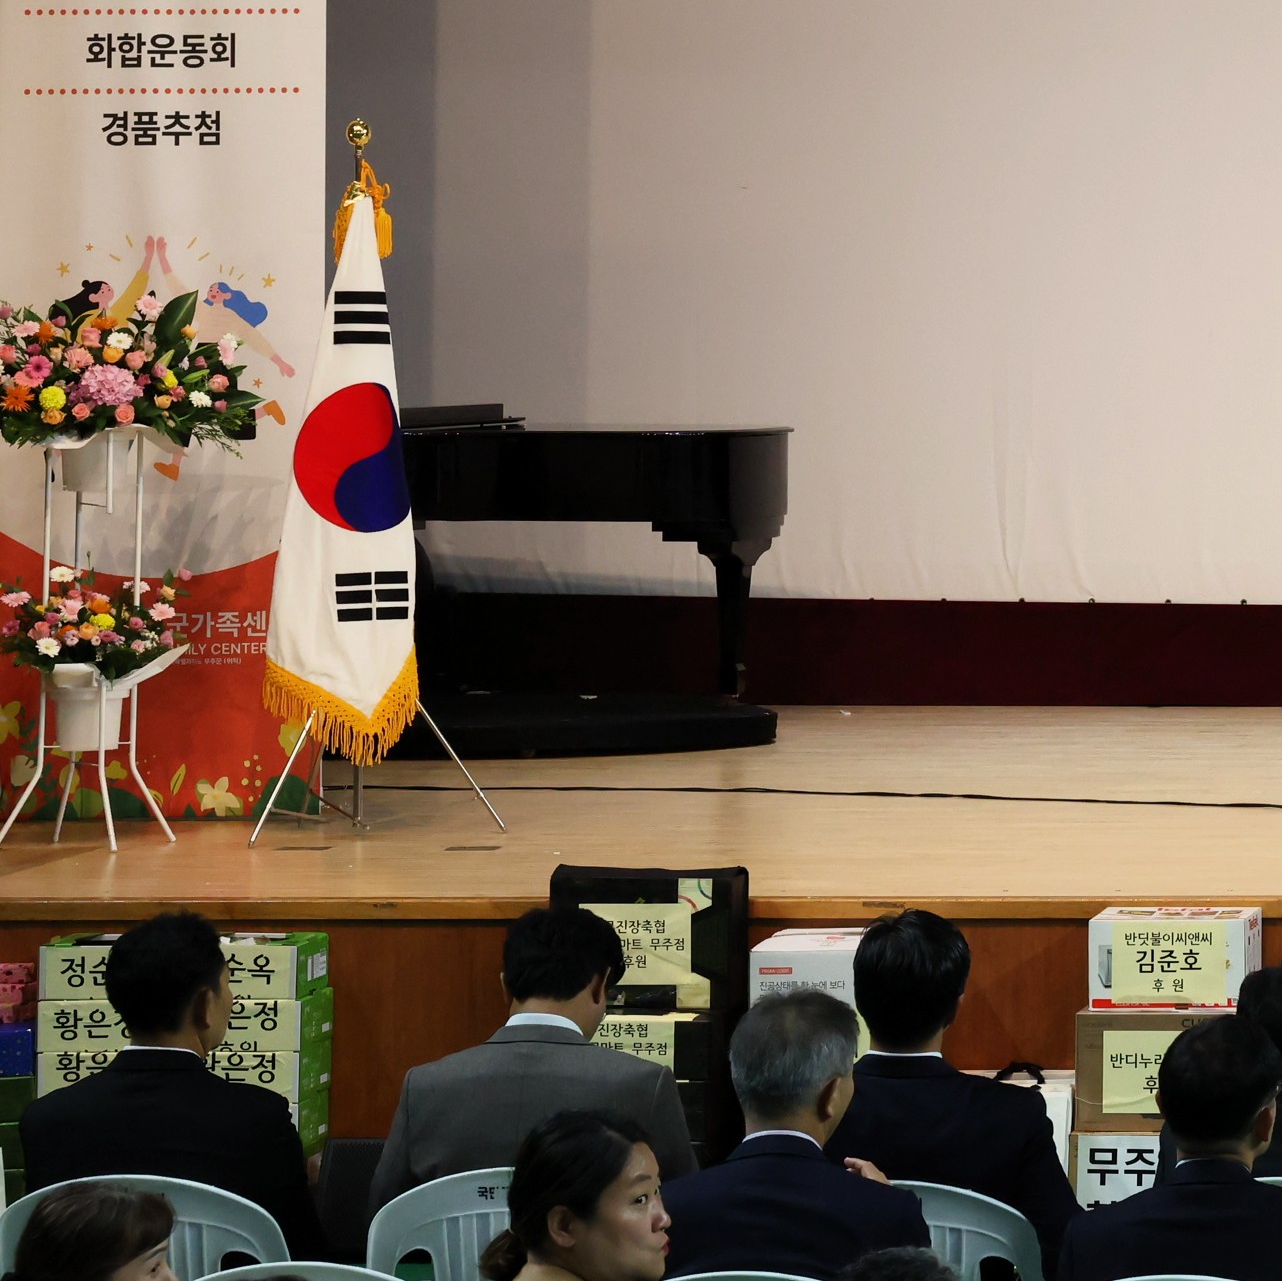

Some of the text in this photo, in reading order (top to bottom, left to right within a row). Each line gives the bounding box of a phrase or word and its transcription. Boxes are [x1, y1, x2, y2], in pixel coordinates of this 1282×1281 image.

[85, 32, 236, 69] 화합운동회
[101, 110, 221, 147] 경품추첨
[649, 938, 686, 952] 무주점
[1124, 931, 1213, 947] 반딧불이씨앤씨
[1135, 948, 1203, 974] 김준호
